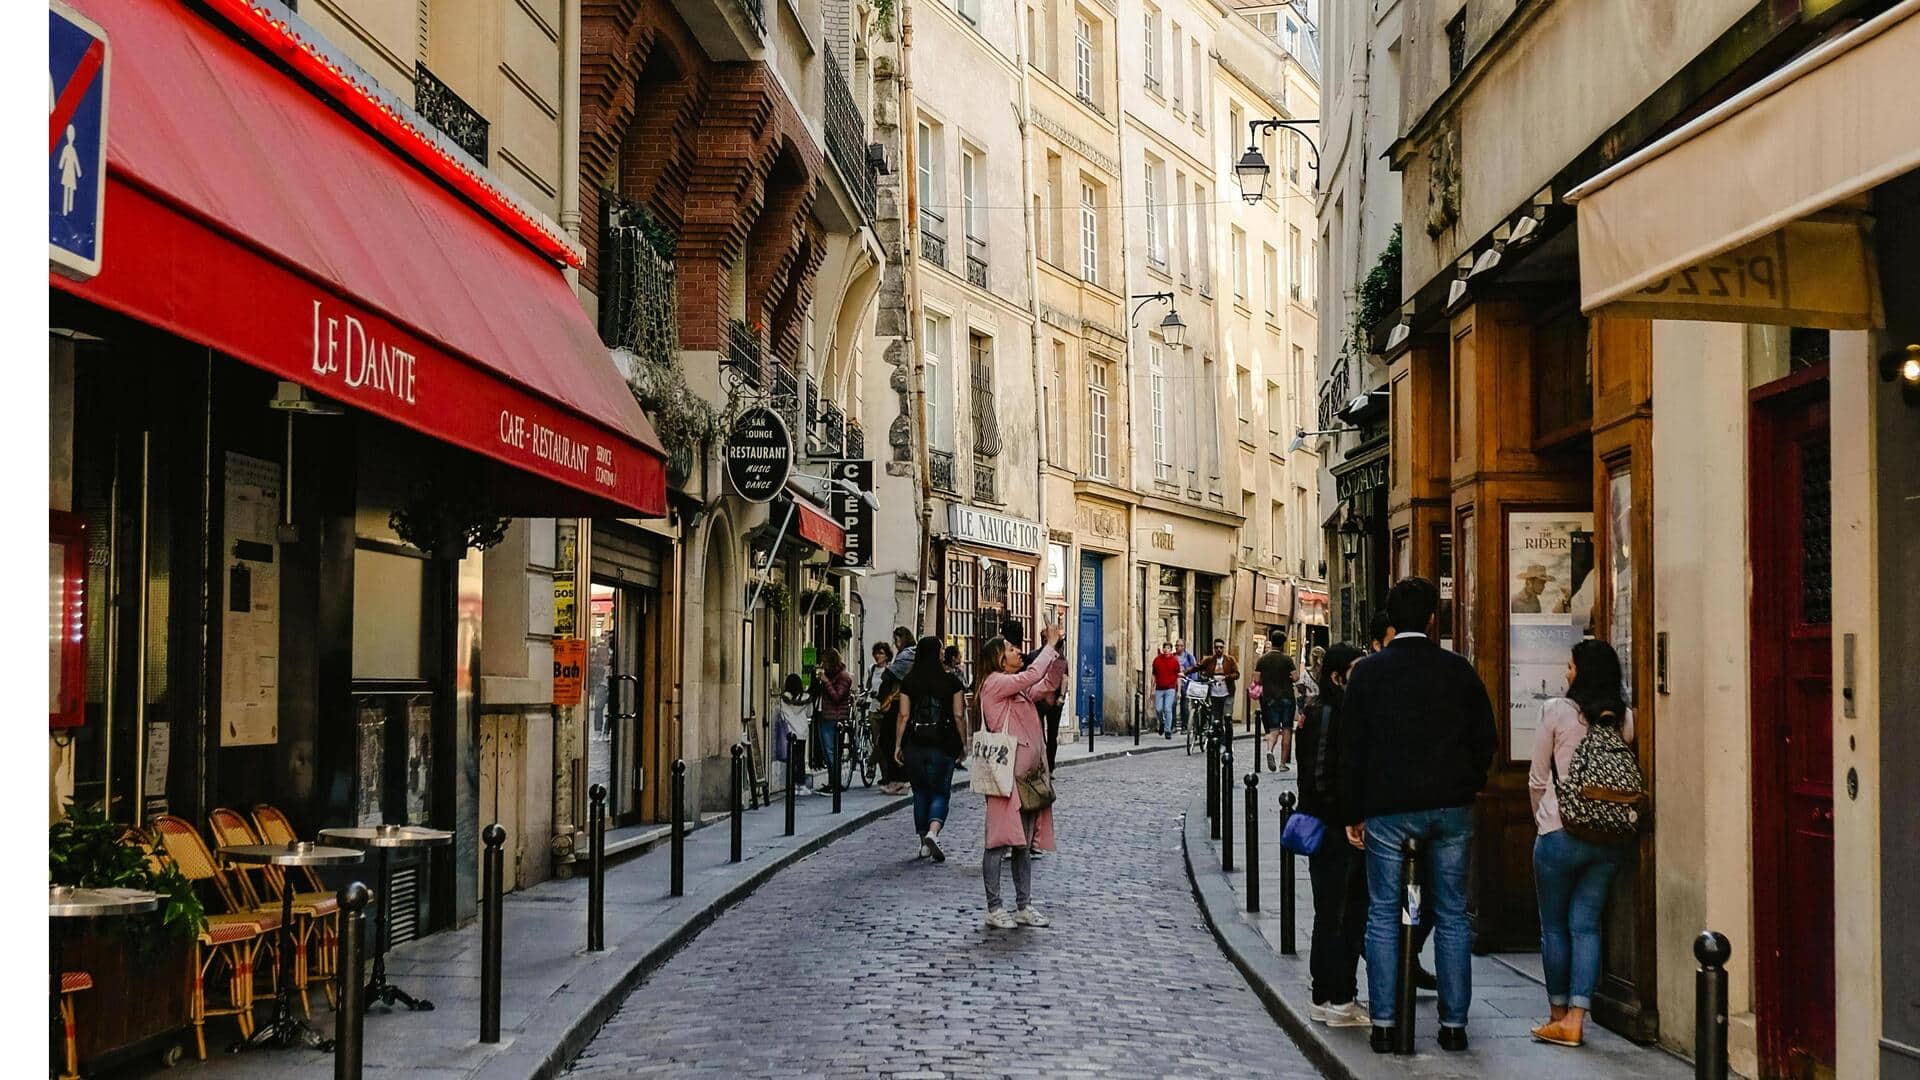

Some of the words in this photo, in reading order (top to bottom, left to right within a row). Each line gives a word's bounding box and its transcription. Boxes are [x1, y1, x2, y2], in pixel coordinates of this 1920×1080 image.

[344, 314, 416, 405] DANTE
[532, 423, 589, 474] RESTAURANT
[730, 446, 787, 459] RESTAURANT
[960, 509, 974, 537] LE
[979, 514, 1039, 549] NAVIGATOR
[1525, 537, 1568, 549] RIDER
